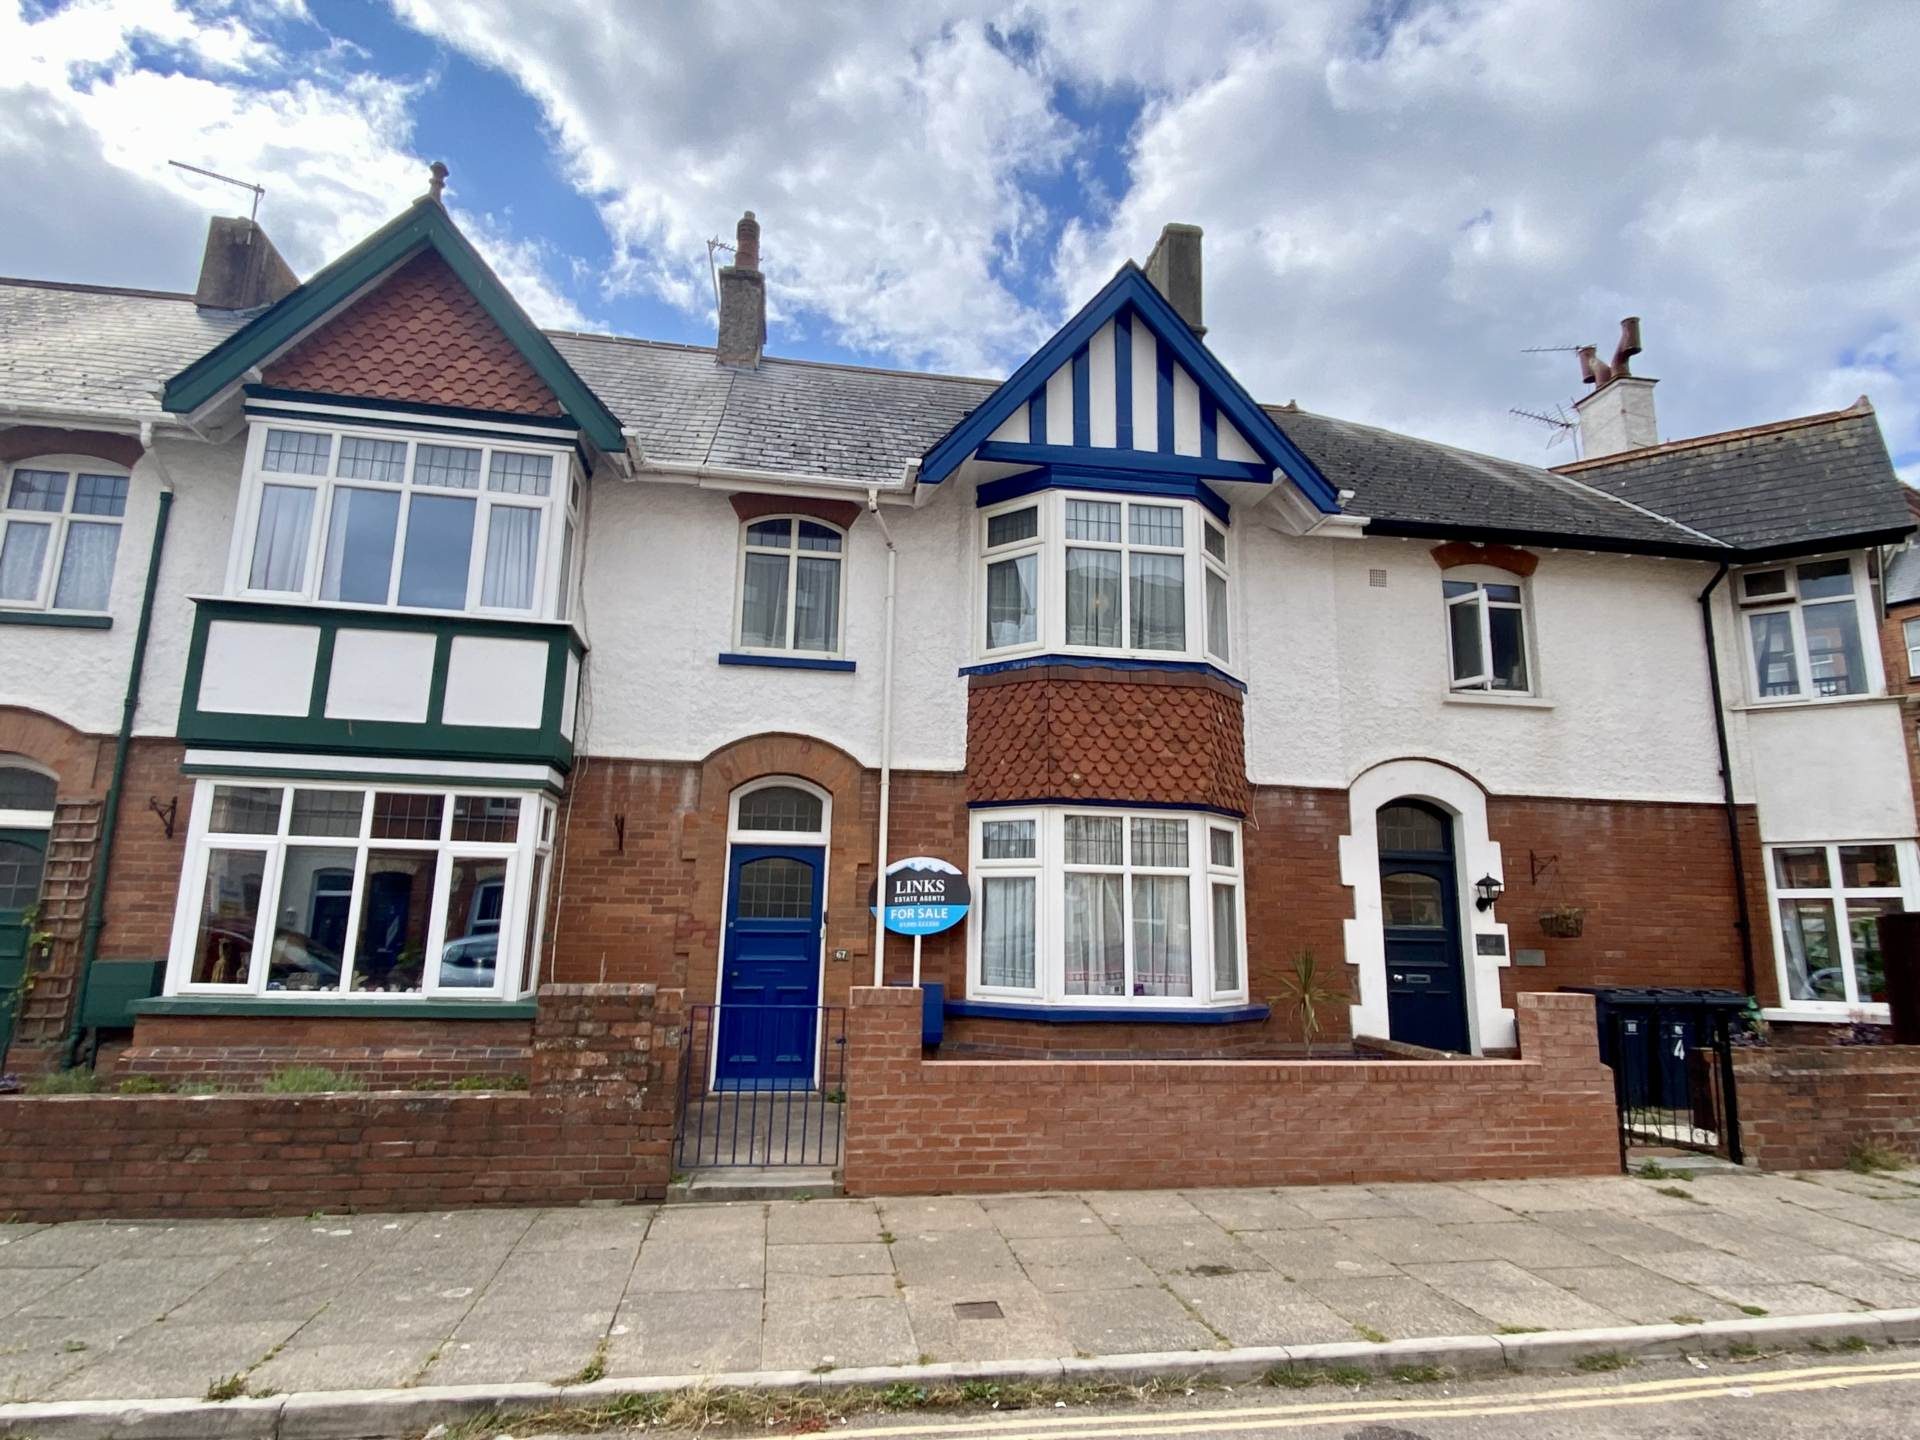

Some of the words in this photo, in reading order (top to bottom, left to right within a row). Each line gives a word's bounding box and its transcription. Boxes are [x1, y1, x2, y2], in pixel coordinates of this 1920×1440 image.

[896, 879, 945, 894] LINKS
[890, 908, 914, 919] FOR
[917, 908, 949, 919] SALE
[836, 950, 847, 959] 67
[1674, 1039, 1685, 1060] 4
